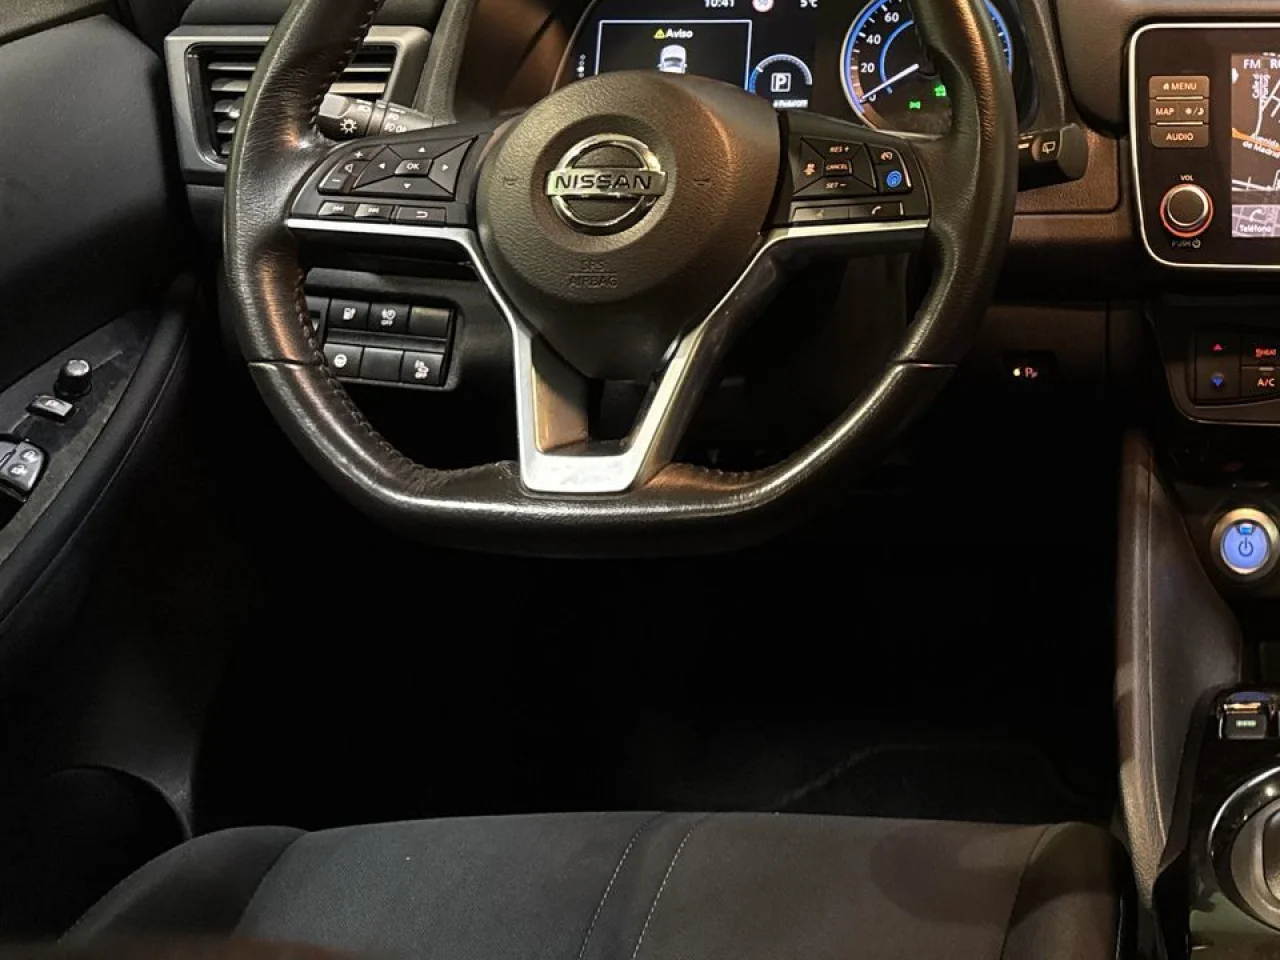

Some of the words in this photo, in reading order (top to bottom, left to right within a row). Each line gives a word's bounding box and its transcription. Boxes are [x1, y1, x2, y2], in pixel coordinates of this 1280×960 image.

[884, 12, 900, 22] 60
[666, 28, 693, 39] Aviso
[866, 34, 881, 44] 40
[860, 63, 875, 73] 20
[1243, 59, 1261, 69] FM
[1171, 82, 1197, 91] MENU
[1155, 107, 1175, 116] MAP
[1166, 132, 1194, 141] AUDIO
[555, 174, 652, 190] NISSAN
[570, 275, 618, 288] AIRBAG
[1257, 378, 1276, 387] A/C
